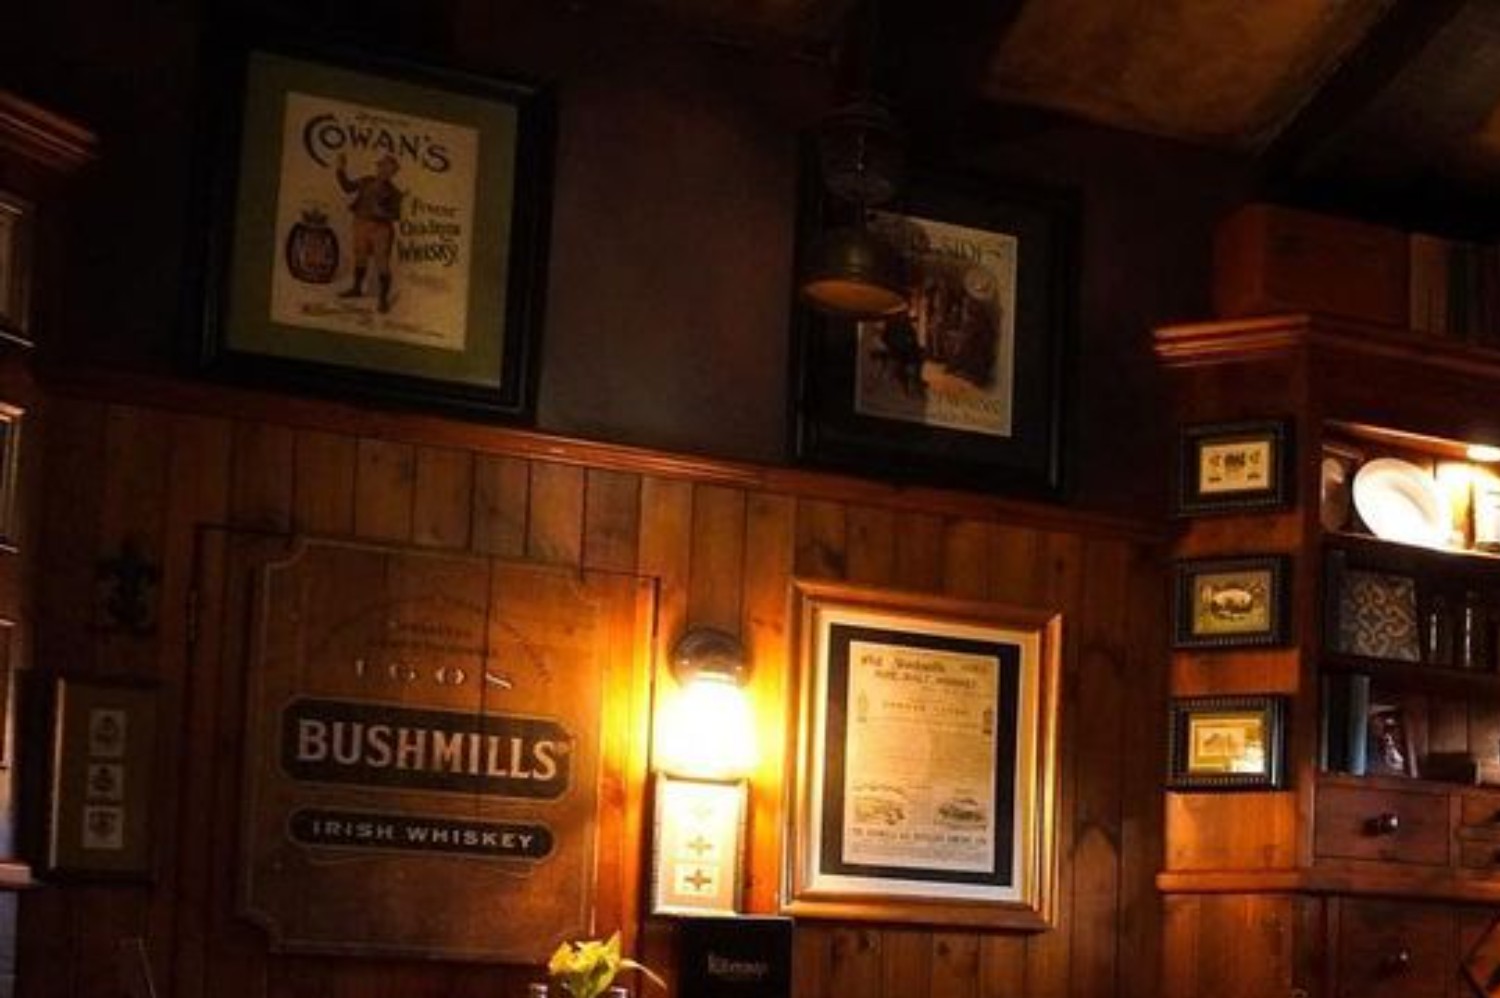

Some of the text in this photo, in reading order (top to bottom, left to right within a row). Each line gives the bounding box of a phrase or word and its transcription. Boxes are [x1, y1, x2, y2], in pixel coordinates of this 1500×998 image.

[304, 113, 450, 173] COWAN'S
[296, 719, 557, 782] BUSHMILLS
[312, 819, 534, 849] IRISH WHISKEY
